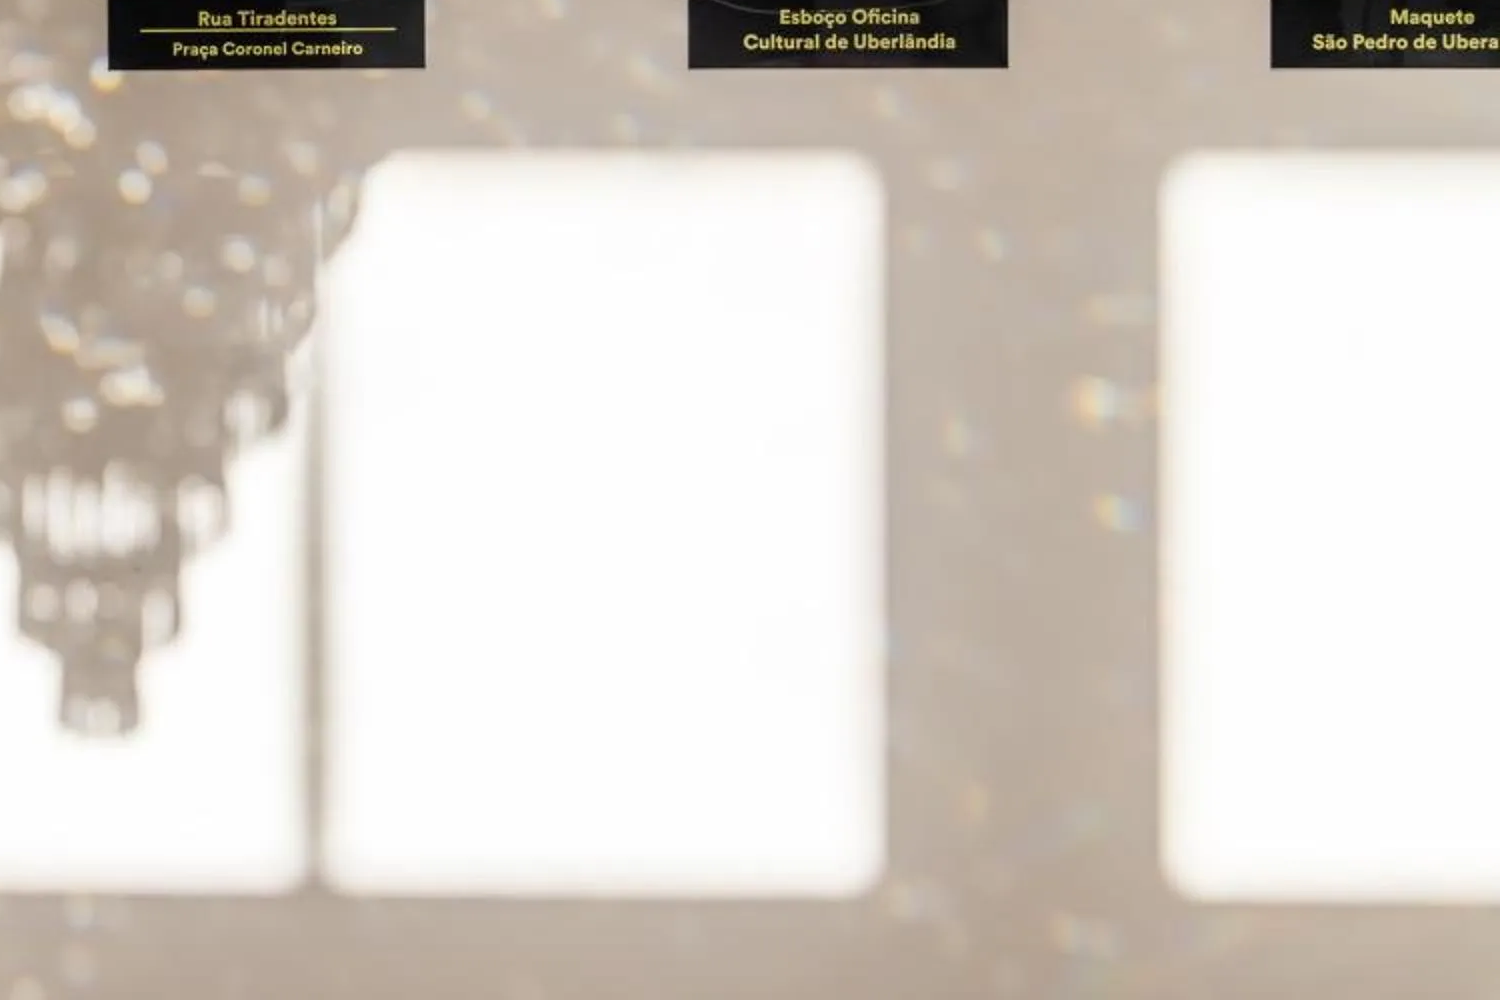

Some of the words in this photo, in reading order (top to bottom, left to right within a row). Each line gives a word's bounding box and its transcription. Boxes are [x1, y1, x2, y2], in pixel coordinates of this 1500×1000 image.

[198, 11, 232, 27] Rua
[237, 10, 338, 26] Tiradentes
[779, 9, 847, 29] Esboço
[852, 8, 920, 25] Oficina
[1389, 8, 1476, 28] Maquete
[172, 42, 218, 60] Praça
[222, 41, 287, 56] Coronel
[291, 40, 364, 56] Carneiro
[743, 33, 821, 51] Cultural
[825, 33, 849, 50] de
[853, 32, 957, 50] Uberlândia
[1312, 33, 1348, 51] São
[1352, 34, 1408, 51] Pedro
[1413, 33, 1438, 50] de
